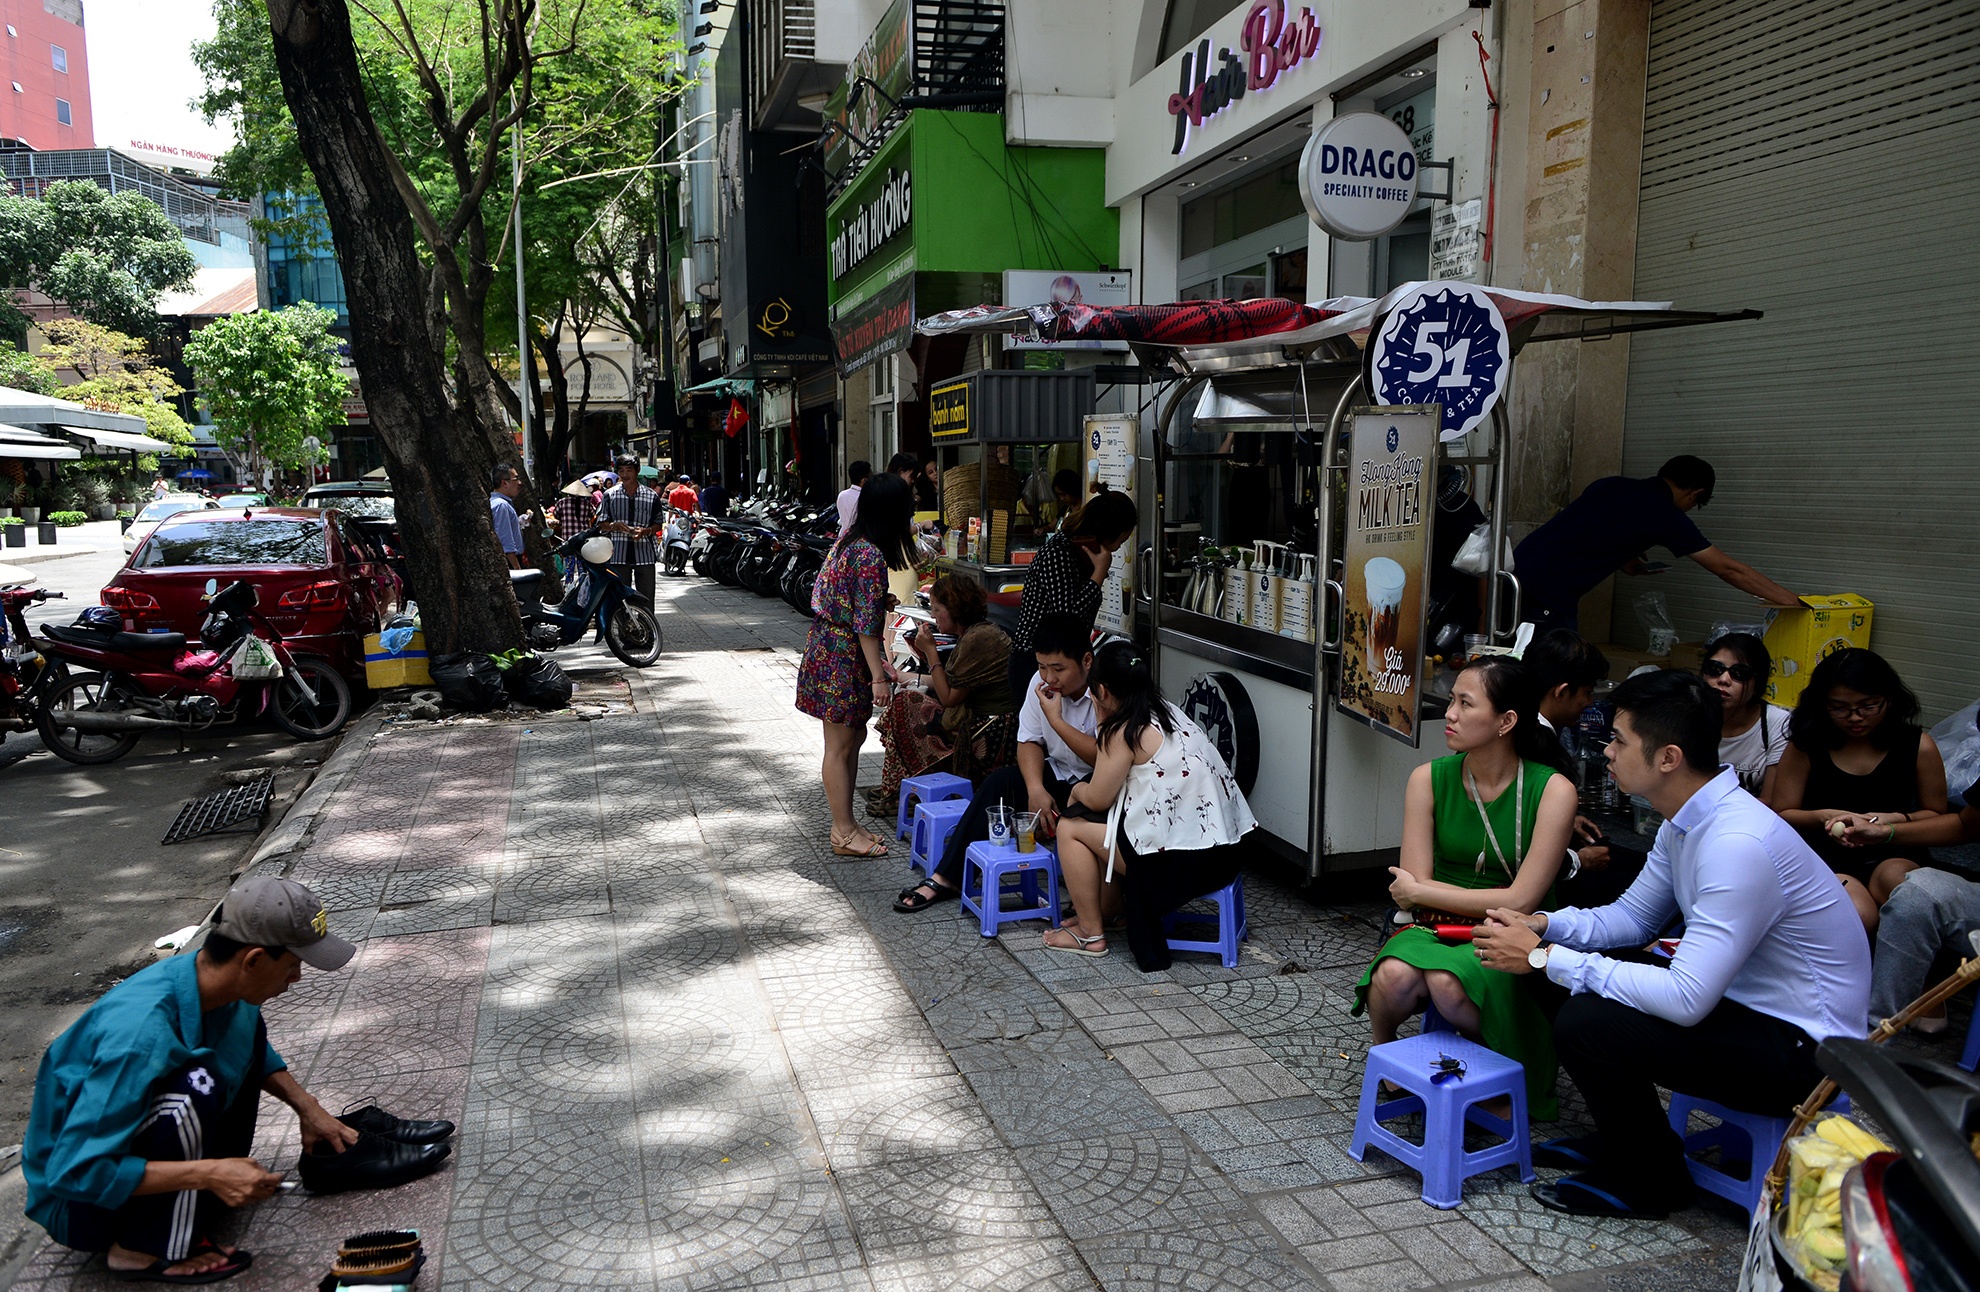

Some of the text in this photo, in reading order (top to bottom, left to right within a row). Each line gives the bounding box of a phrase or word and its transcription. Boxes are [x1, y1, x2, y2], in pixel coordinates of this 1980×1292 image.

[1168, 39, 1247, 155] Hair
[130, 139, 154, 151] NGÂN
[156, 143, 179, 155] HÀNG
[1321, 144, 1416, 181] DRAGO
[1323, 182, 1408, 202] SPECIALTY COFFEE
[831, 219, 847, 281] TRÀ
[756, 297, 792, 337] KOI
[1407, 321, 1473, 388] 51
[1446, 387, 1482, 418] & TEA
[1357, 479, 1421, 531] MILK TEA
[1384, 646, 1404, 676] Giá
